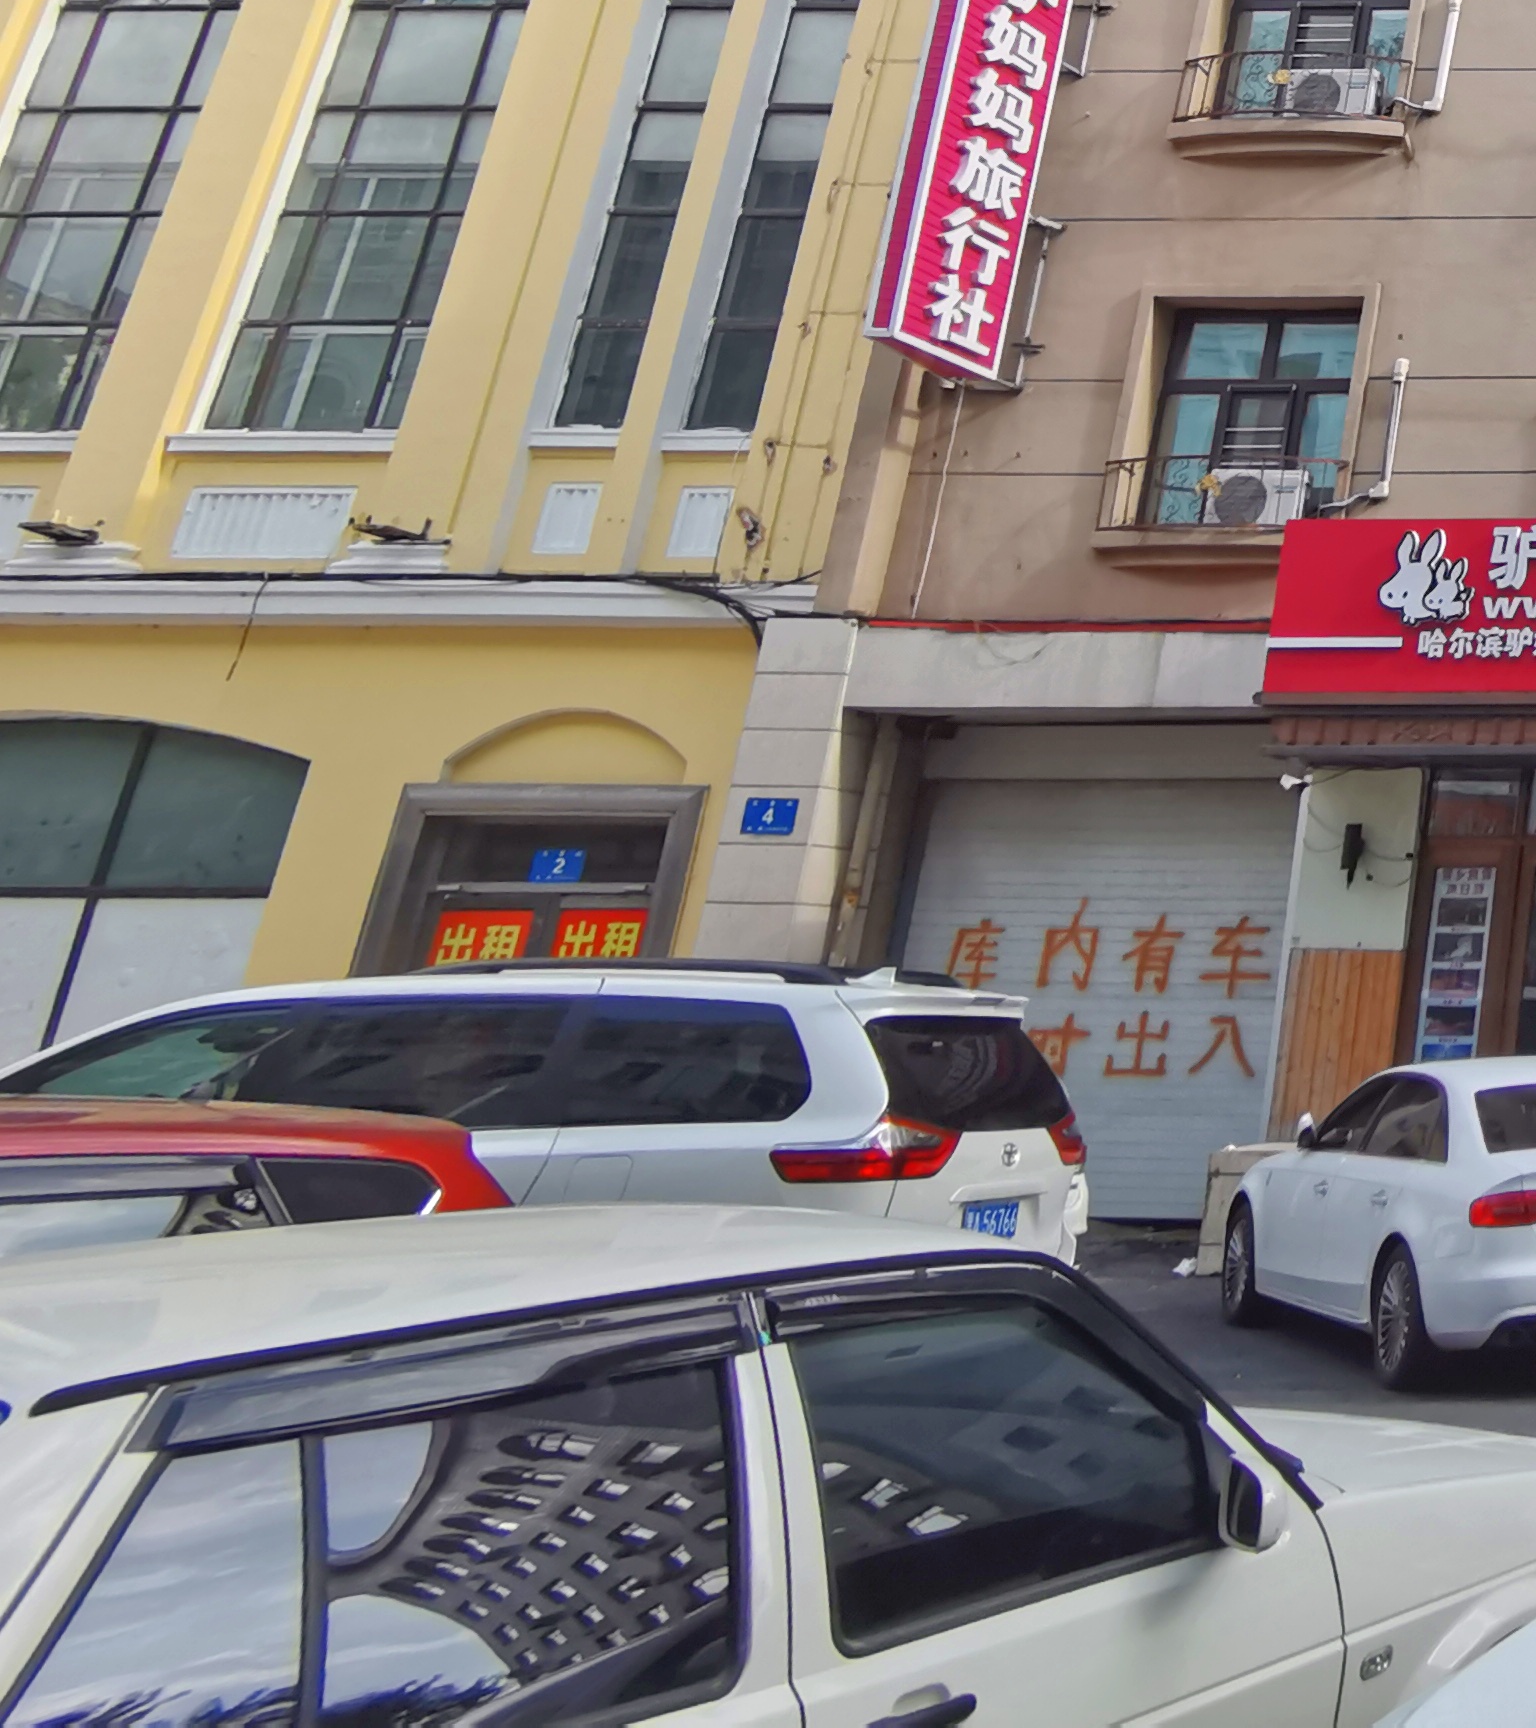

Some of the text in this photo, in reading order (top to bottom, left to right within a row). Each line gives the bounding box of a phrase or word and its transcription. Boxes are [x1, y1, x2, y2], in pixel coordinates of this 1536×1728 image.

[762, 807, 774, 825] 4
[552, 857, 566, 874] 2
[435, 923, 521, 966] 出租
[558, 920, 641, 958] 出租
[947, 896, 1271, 999] 库内有车
